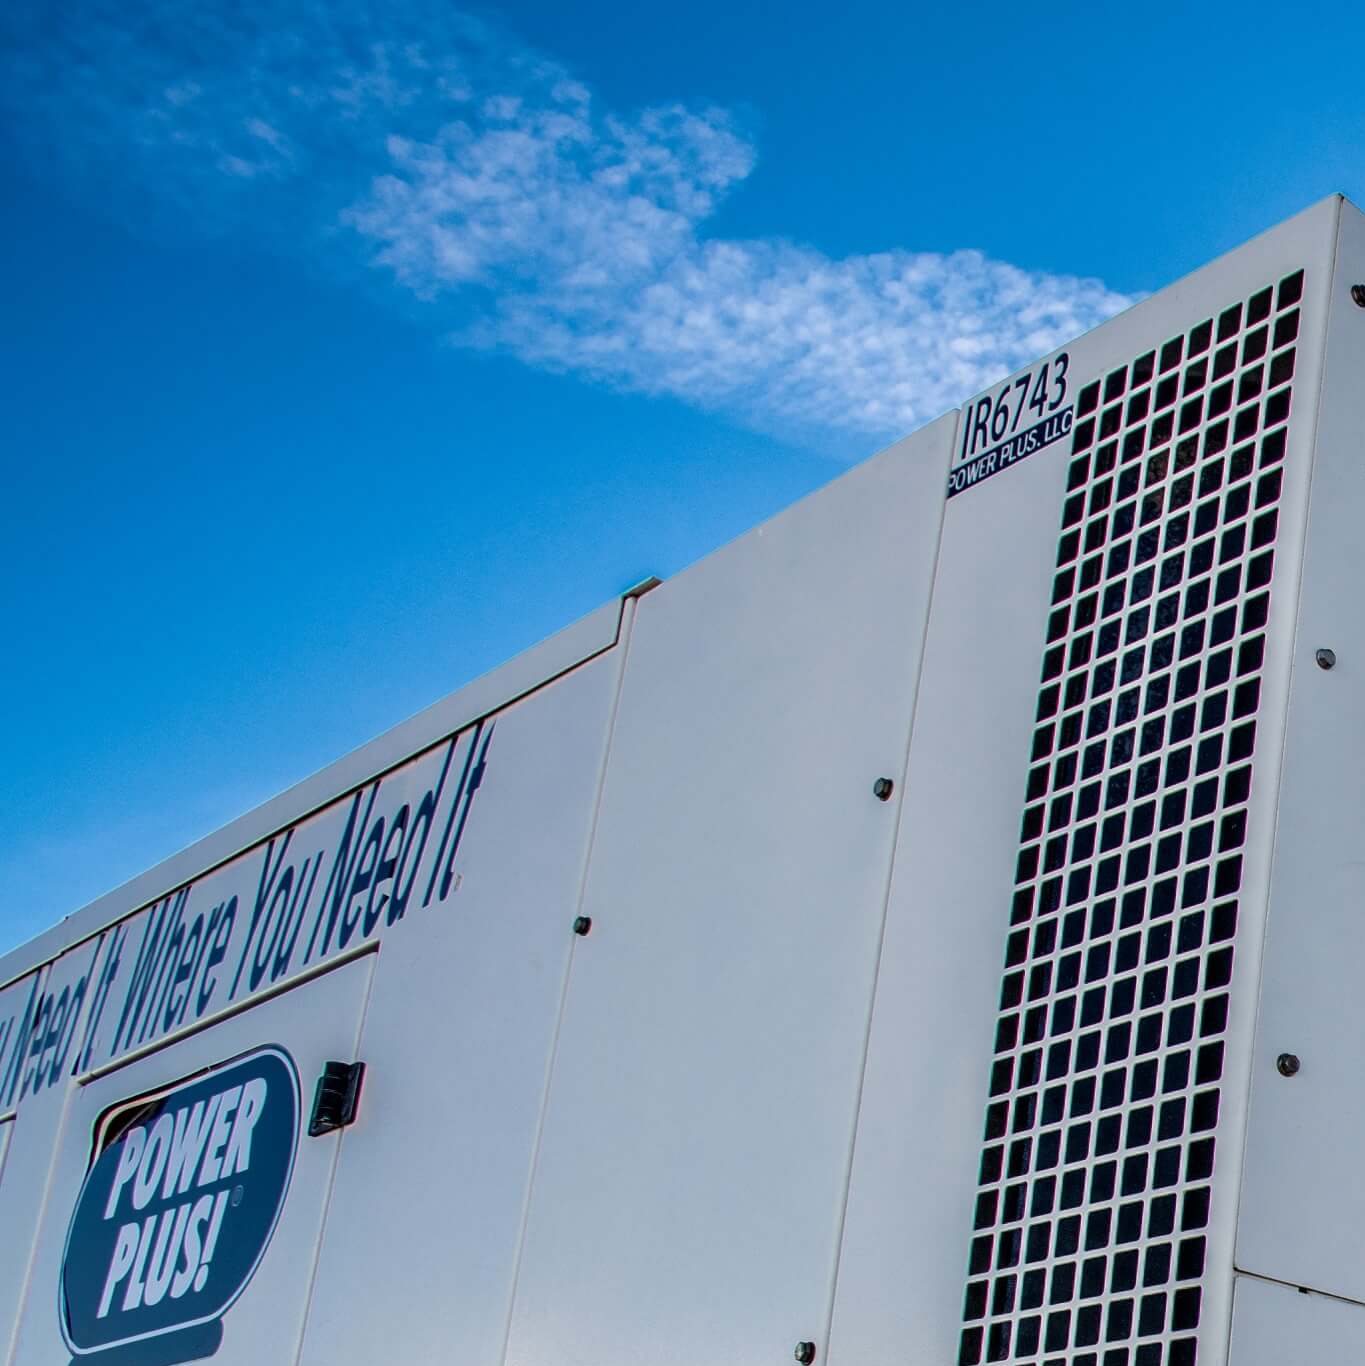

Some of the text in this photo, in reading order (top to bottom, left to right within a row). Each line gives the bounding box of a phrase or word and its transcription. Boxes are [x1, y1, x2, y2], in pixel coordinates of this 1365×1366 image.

[948, 451, 996, 490] POWER
[1043, 410, 1073, 443] LLC
[961, 352, 1069, 460] IR6743
[111, 884, 238, 1056] Where
[229, 828, 324, 1000] You
[303, 736, 459, 965] Need
[422, 719, 497, 908] It
[103, 1077, 267, 1220] POWER
[96, 1189, 230, 1318] PLUS!
